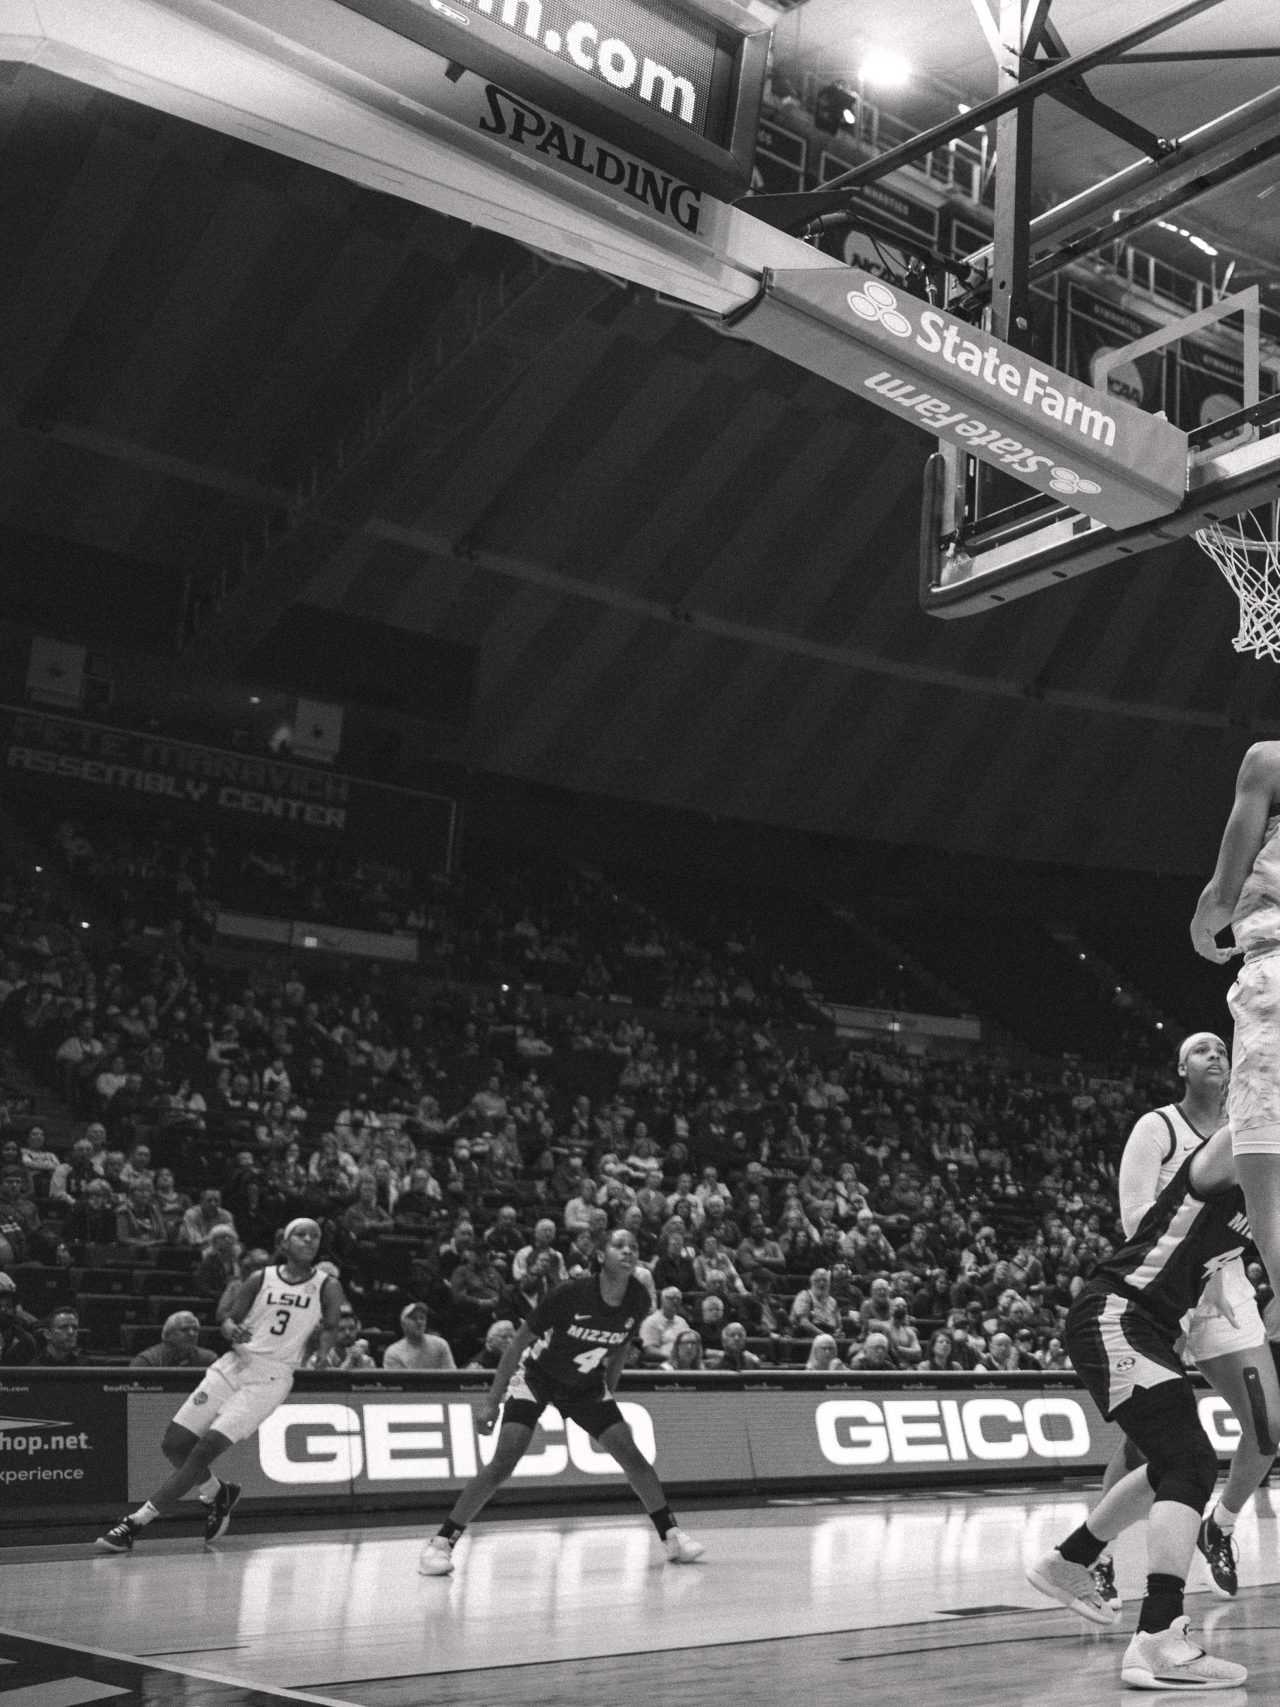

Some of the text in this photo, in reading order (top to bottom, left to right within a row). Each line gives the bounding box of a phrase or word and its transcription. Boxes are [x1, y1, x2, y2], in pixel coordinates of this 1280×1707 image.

[479, 83, 701, 234] SPALDING
[218, 786, 347, 831] CENTER
[266, 1292, 311, 1309] LSU
[270, 1309, 291, 1336] 3
[573, 1347, 609, 1375] 4
[258, 1402, 657, 1486] GEICO
[815, 1397, 1091, 1466] GEICO
